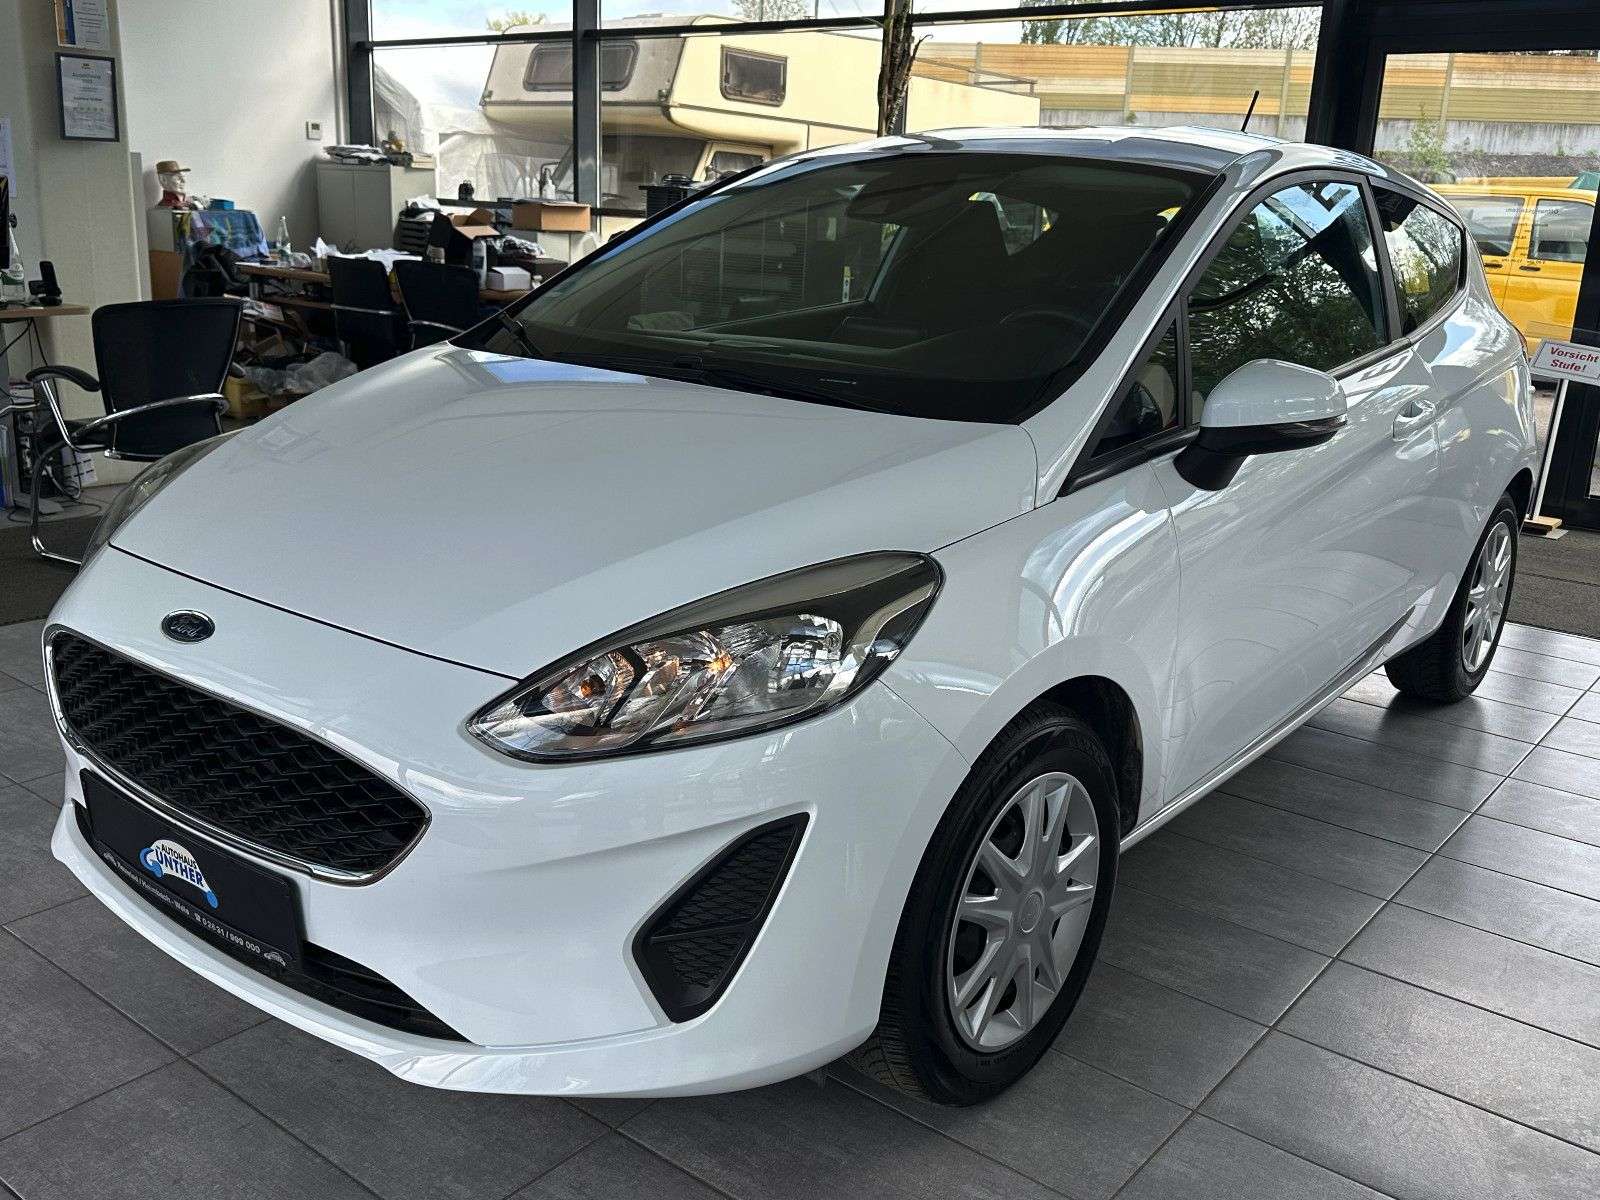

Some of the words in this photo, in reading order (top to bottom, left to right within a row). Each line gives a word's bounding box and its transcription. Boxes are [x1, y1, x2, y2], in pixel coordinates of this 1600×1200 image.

[1550, 346, 1599, 363] Vorsicht
[1550, 359, 1588, 372] Stufe!
[161, 843, 198, 870] AUTOHAUS
